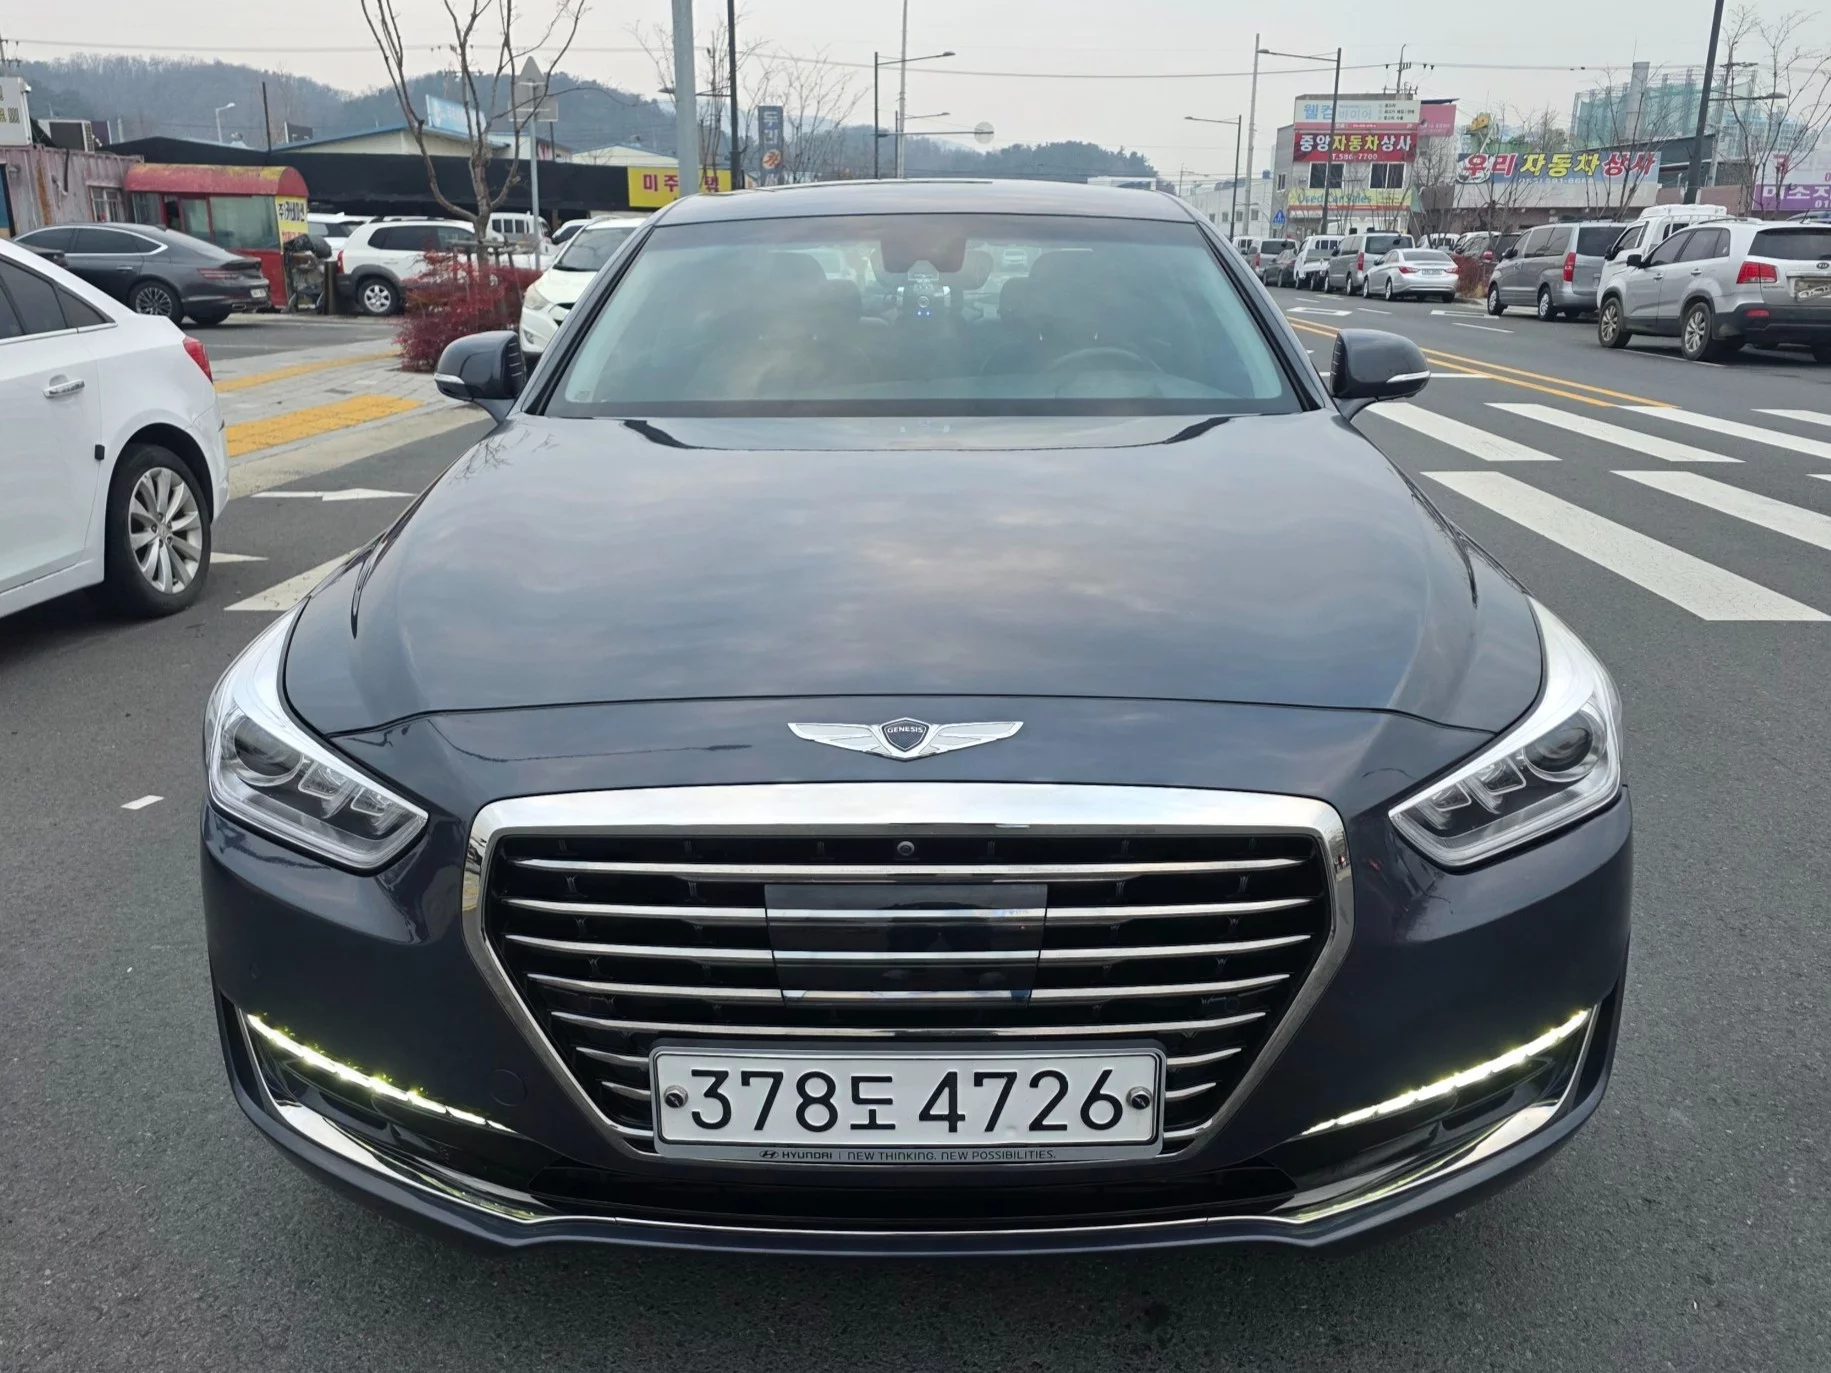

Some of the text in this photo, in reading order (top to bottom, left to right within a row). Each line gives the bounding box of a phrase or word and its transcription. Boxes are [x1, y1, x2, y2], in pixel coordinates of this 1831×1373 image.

[690, 1068, 1124, 1133] 378도 4726
[782, 1150, 1057, 1161] HYUNDAI NEW THINKING. NEW POSSIBILITIES.
